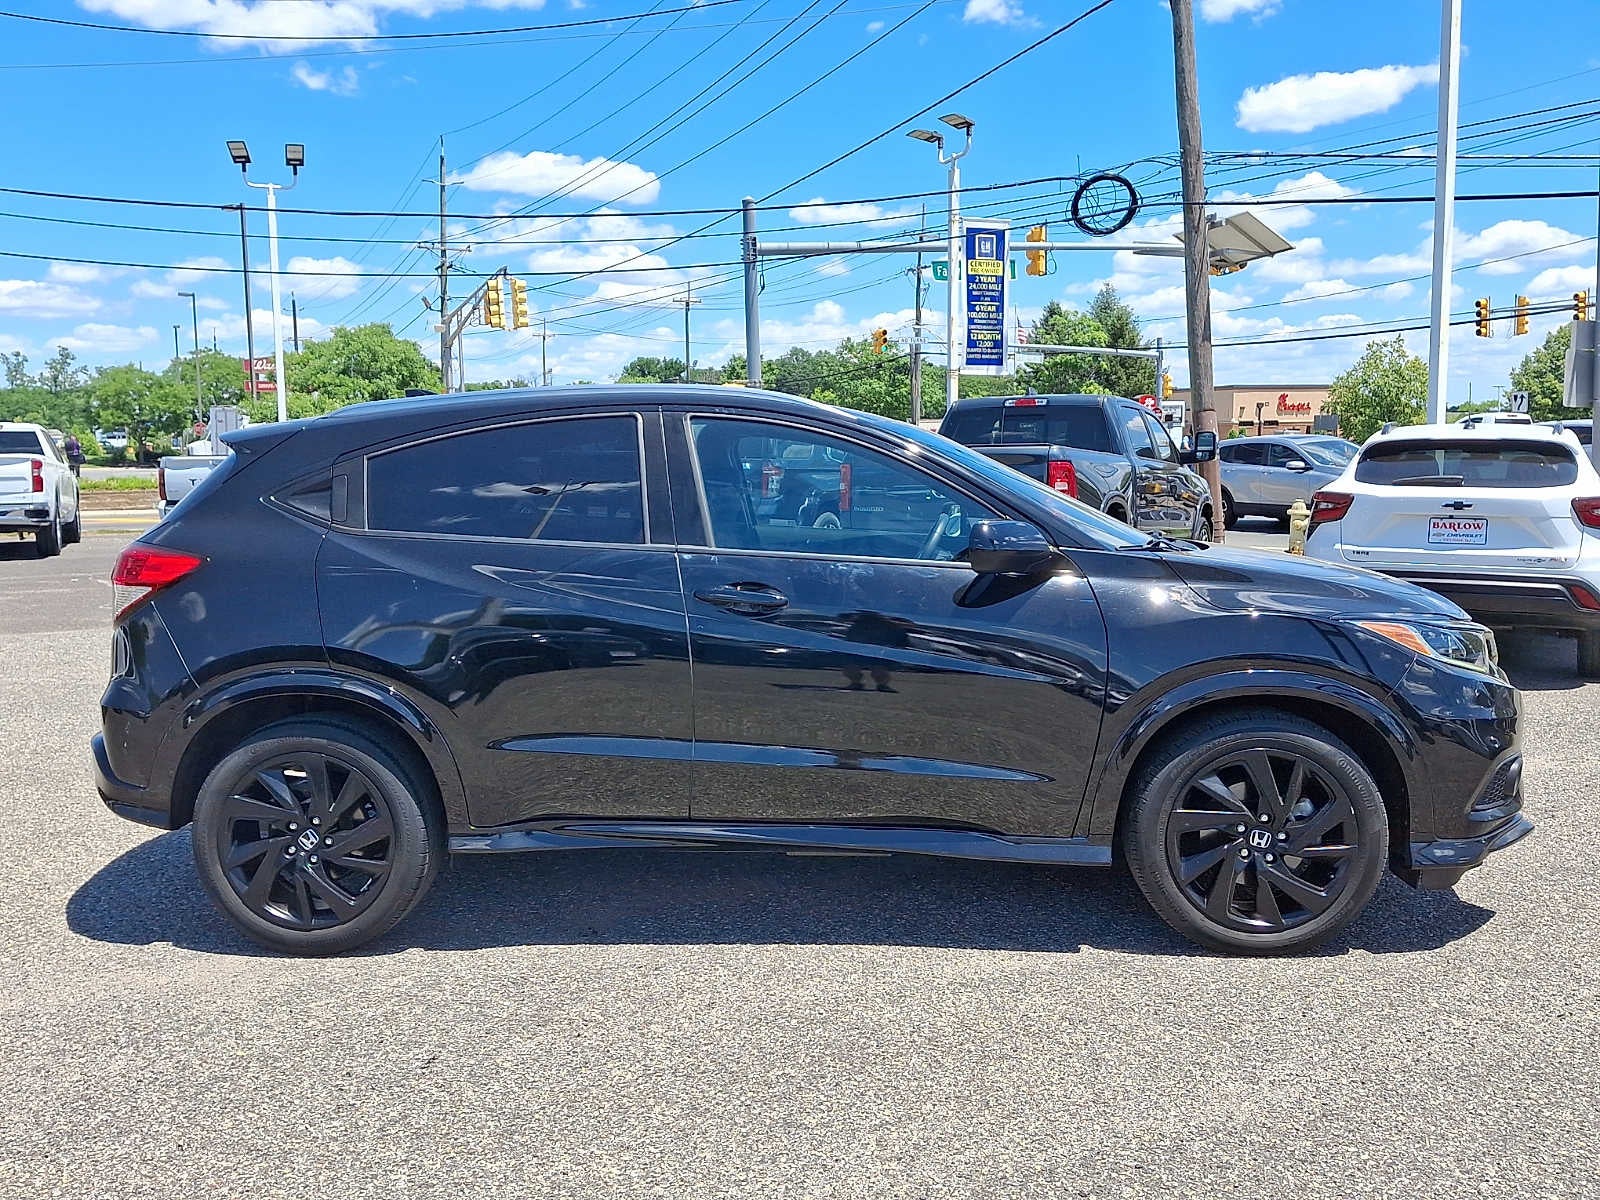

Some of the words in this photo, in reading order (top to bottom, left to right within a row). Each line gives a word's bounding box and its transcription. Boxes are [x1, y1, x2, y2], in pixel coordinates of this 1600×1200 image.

[980, 275, 996, 283] YEAR
[988, 283, 1002, 291] MILE
[1432, 521, 1484, 532] BARLOW
